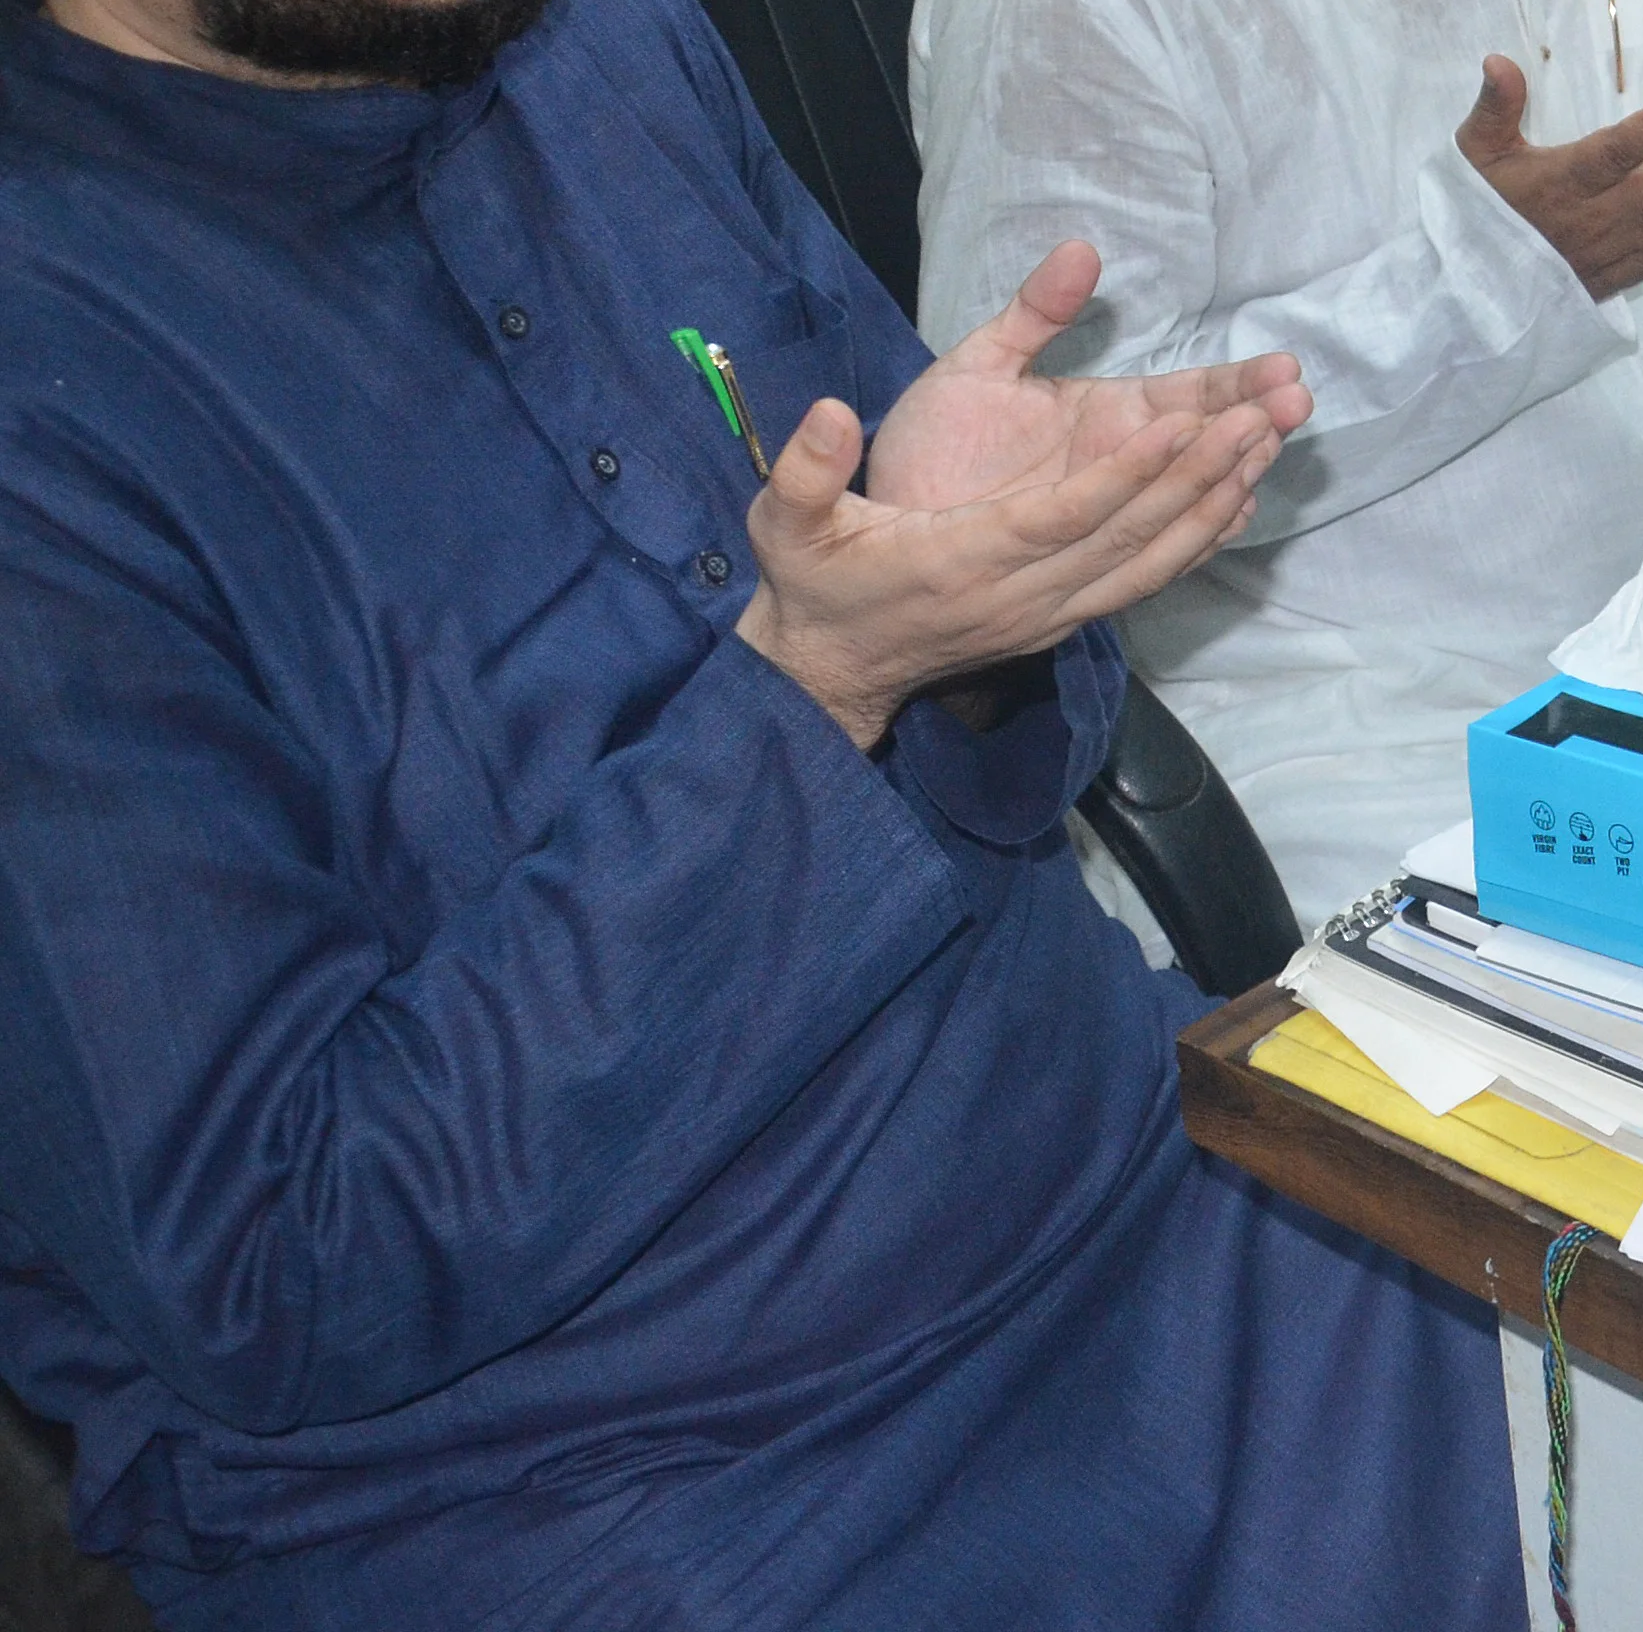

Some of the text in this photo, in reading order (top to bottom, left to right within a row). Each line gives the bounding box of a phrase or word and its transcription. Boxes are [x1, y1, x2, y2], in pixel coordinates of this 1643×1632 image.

[1532, 834, 1557, 846] VIRGIN
[1534, 843, 1556, 854] FIBRE
[1572, 845, 1594, 856] EXACT
[1572, 854, 1596, 865] COUNT
[1615, 856, 1630, 867] TWO
[1617, 866, 1630, 876] PLY
